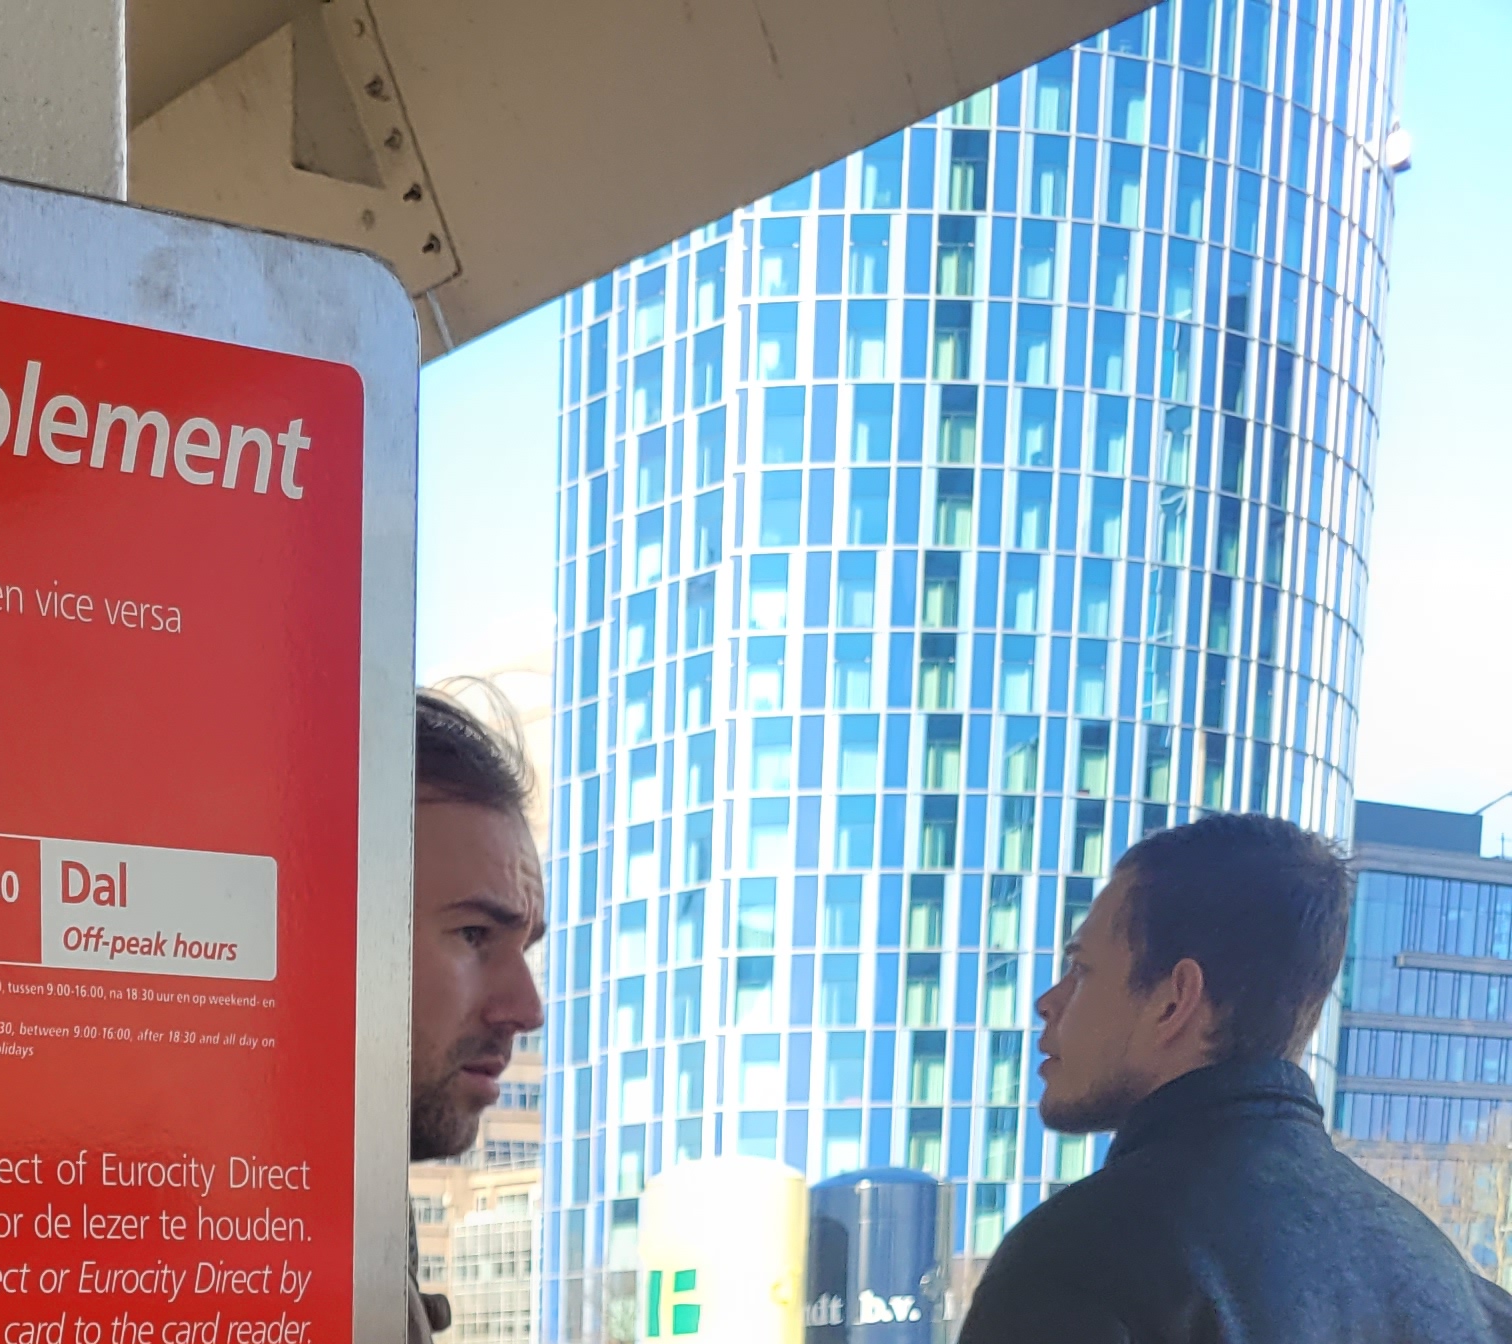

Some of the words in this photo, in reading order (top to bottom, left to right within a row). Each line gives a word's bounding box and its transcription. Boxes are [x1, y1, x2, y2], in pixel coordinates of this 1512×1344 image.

[35, 580, 94, 623] vice
[104, 598, 181, 634] versa
[61, 860, 127, 908] Dal
[63, 926, 168, 961] Off-peak
[173, 932, 238, 961] hours
[7, 982, 44, 996] tussen
[109, 989, 123, 1000] na
[156, 992, 174, 1003] uur
[177, 994, 190, 1004] en
[192, 995, 206, 1008] op
[262, 997, 275, 1008] en
[19, 1022, 69, 1038] between
[137, 1028, 164, 1042] after
[199, 1032, 219, 1045] and
[223, 1033, 235, 1045] all
[239, 1034, 258, 1049] day
[261, 1038, 275, 1048] on
[56, 1149, 88, 1185] of
[102, 1152, 216, 1198] Eurocity
[229, 1156, 311, 1190] Direct
[34, 1202, 71, 1239] de
[83, 1203, 150, 1240] lezer
[158, 1210, 187, 1241] te
[198, 1205, 312, 1243] houden.
[39, 1268, 71, 1294] or
[78, 1260, 187, 1303] Eurocity
[194, 1261, 273, 1294] Direct
[279, 1259, 313, 1303] by
[858, 1289, 922, 1325] b.v.
[226, 1311, 312, 1344] reader.
